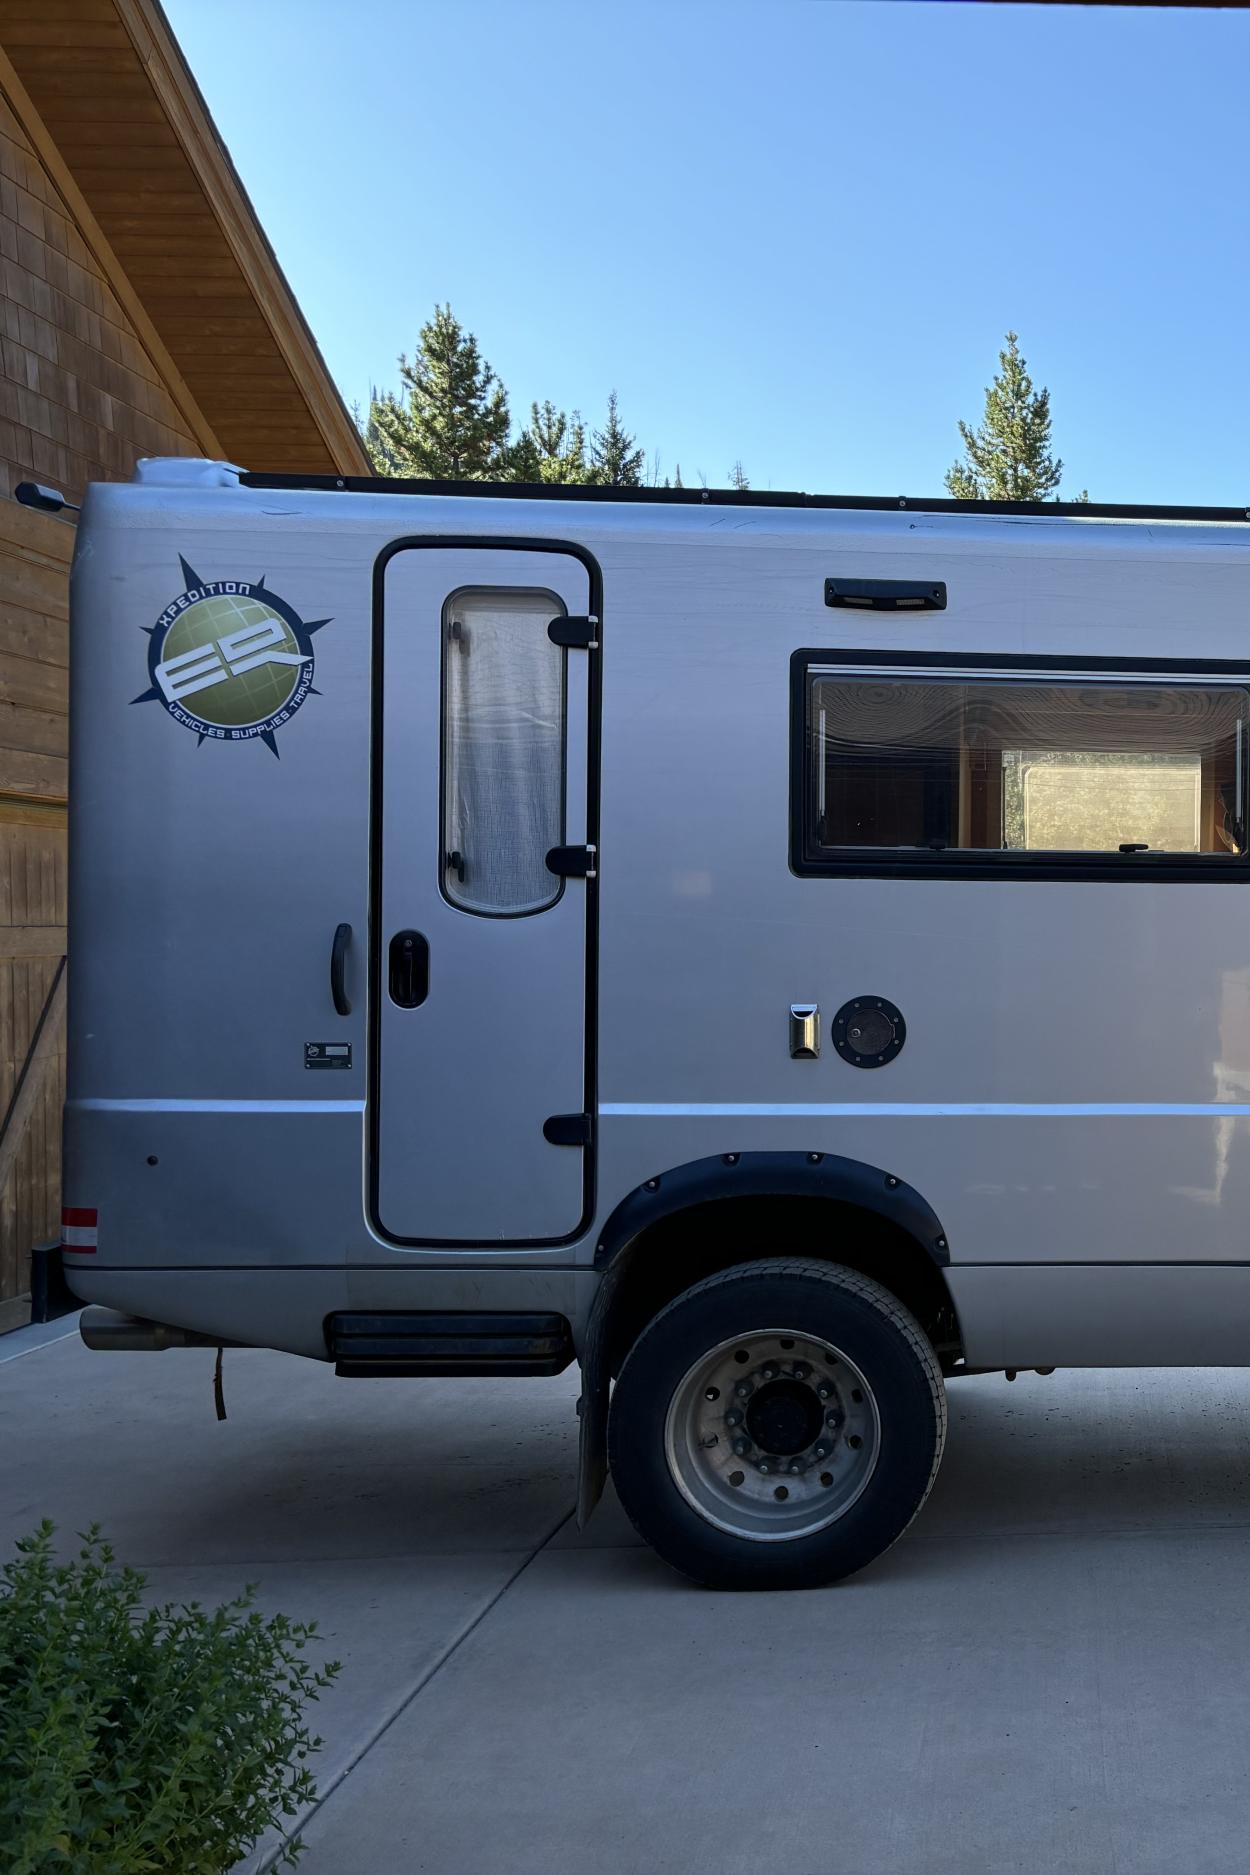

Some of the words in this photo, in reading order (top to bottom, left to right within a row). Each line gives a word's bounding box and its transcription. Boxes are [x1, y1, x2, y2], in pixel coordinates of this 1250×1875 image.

[159, 582, 250, 627] XPEDITION
[168, 701, 225, 739] VEHICLES
[231, 711, 290, 740] SUPPLIES
[289, 662, 313, 709] TRAVEL
